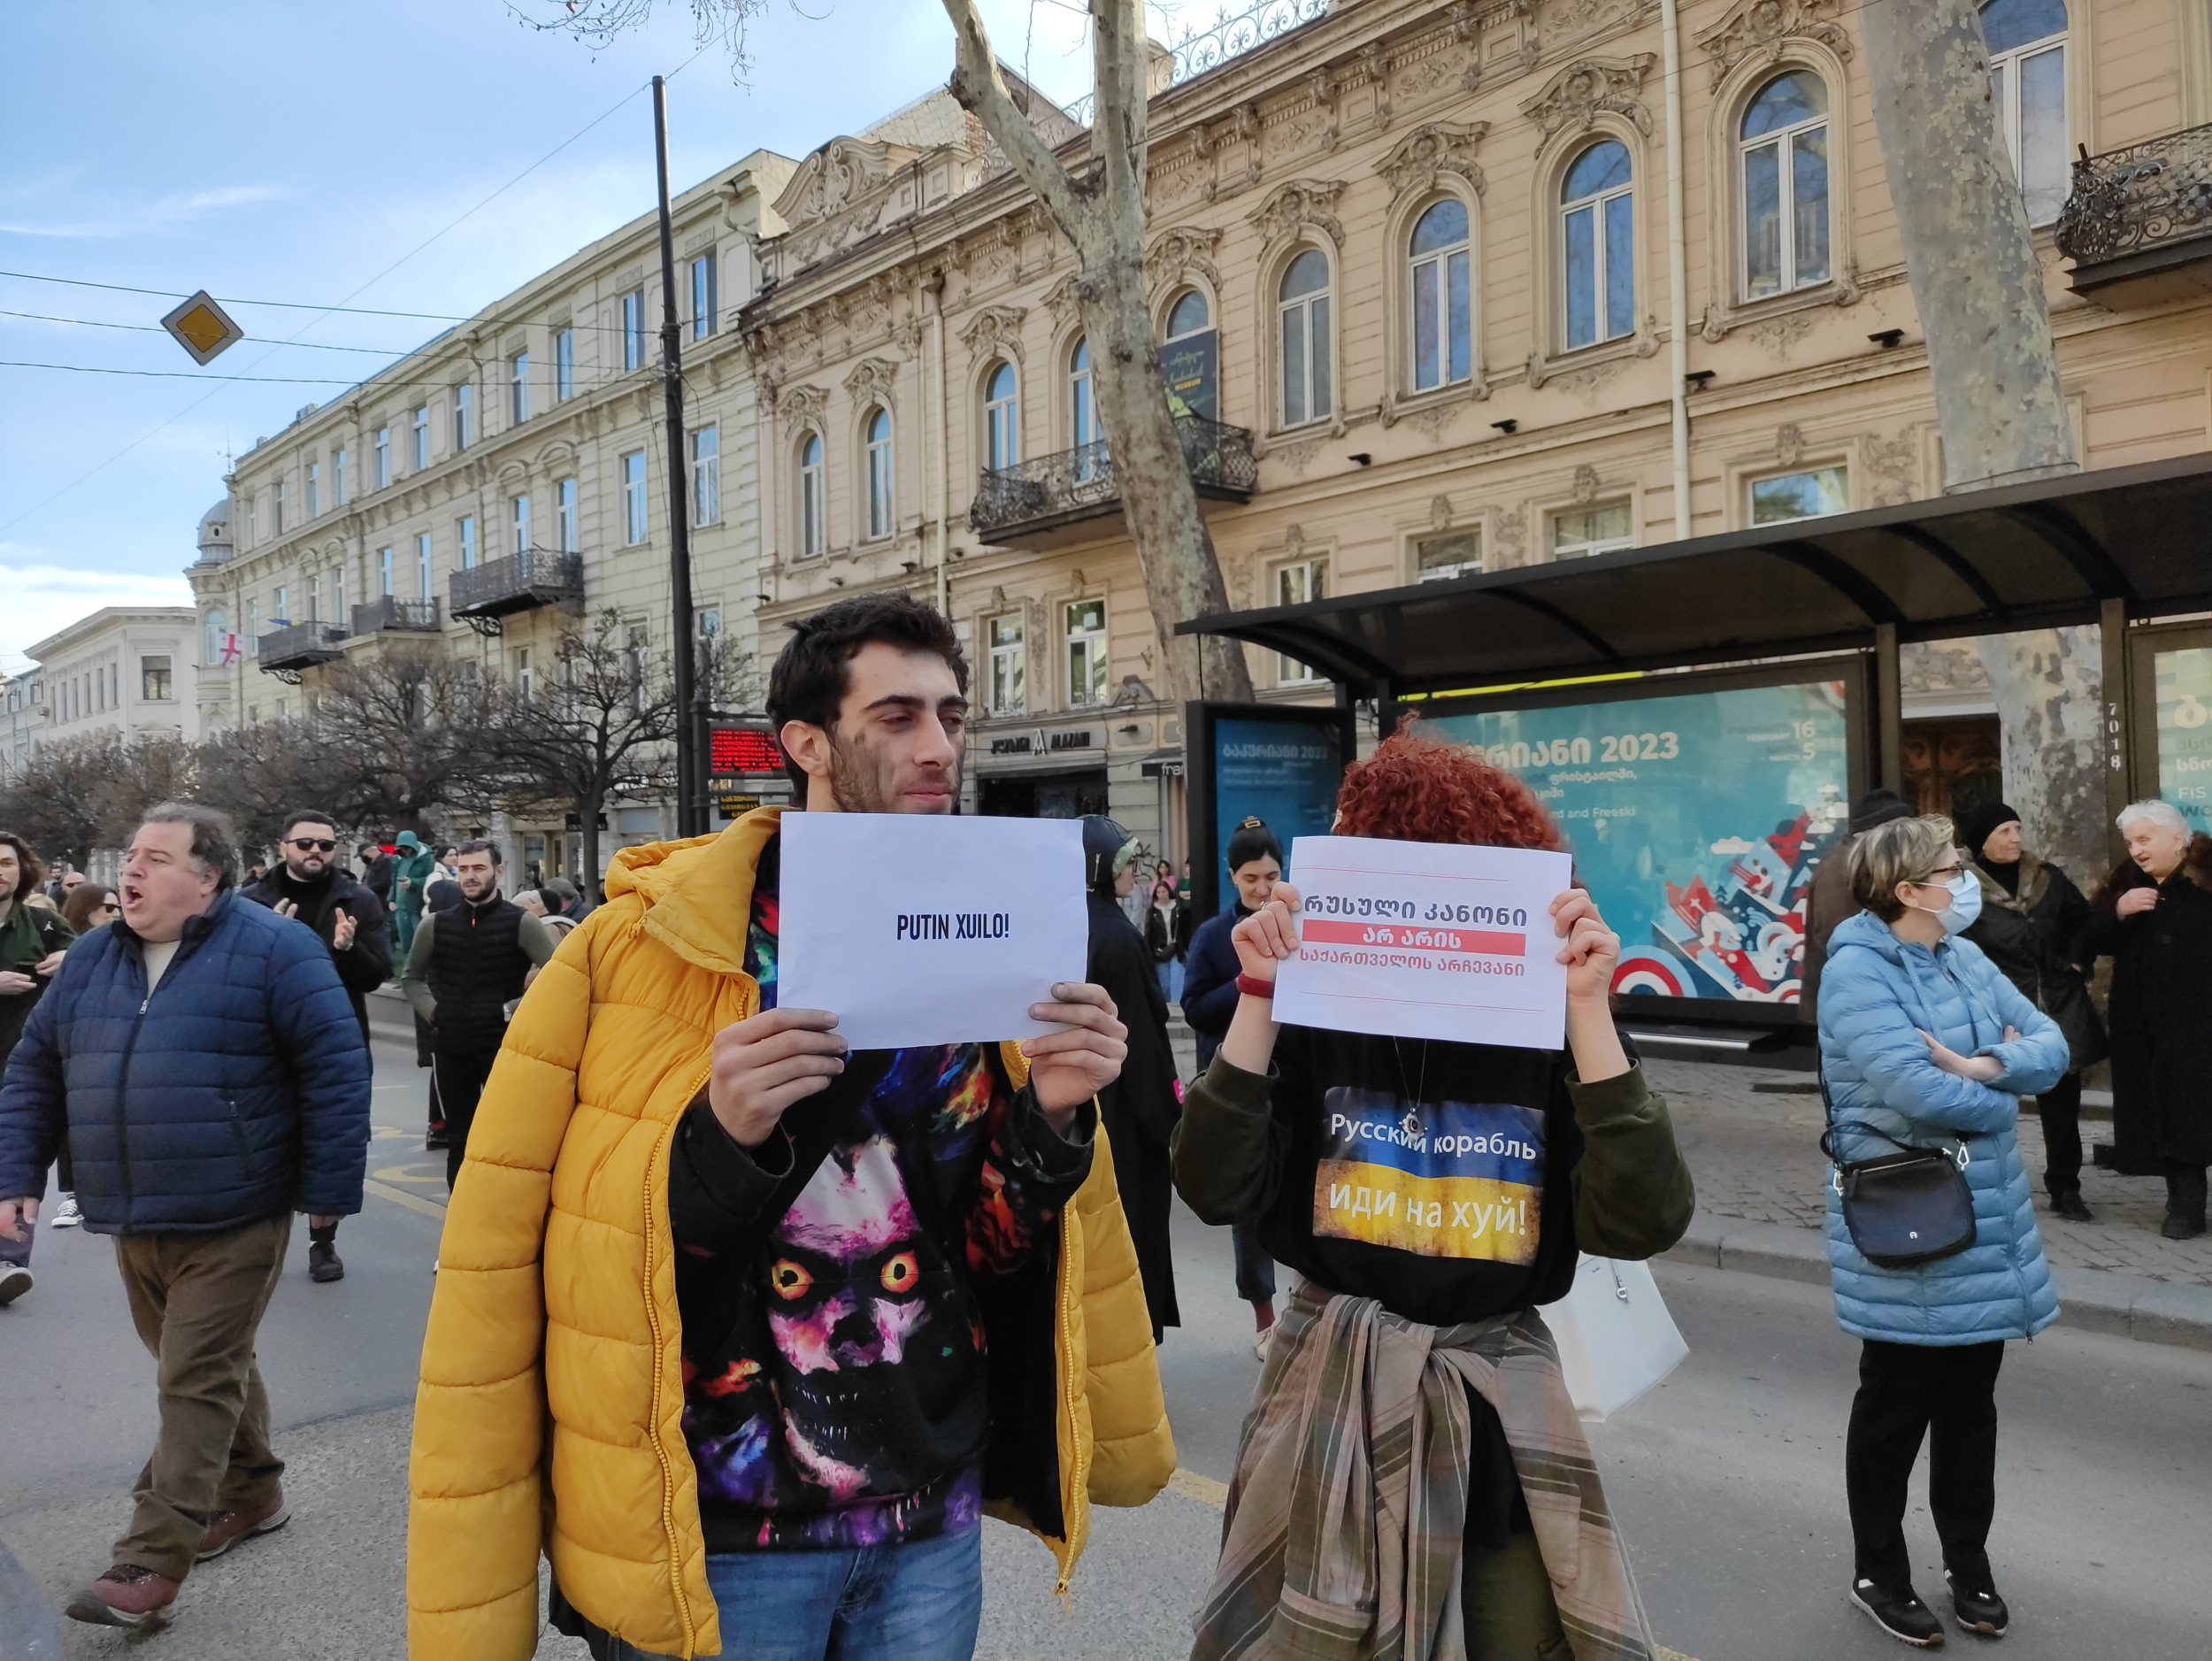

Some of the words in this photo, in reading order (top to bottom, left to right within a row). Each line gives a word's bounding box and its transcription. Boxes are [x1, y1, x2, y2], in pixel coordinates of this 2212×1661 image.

[1793, 721, 1816, 739] 16
[1599, 731, 1679, 763] 2023
[1802, 742, 1816, 760] 5
[2178, 786, 2208, 800] FIS
[1567, 807, 1589, 819] and
[1593, 805, 1636, 819] Freeski
[1304, 896, 1416, 919] რუსული
[1424, 903, 1527, 927] კანონი
[896, 914, 949, 941] PUTIN
[955, 913, 1009, 940] XUILO!
[1363, 927, 1394, 945] არ
[1401, 929, 1462, 950] არის
[1300, 948, 1432, 970] საქართველოს
[1437, 957, 1525, 977] არჩევანი
[1433, 1132, 1537, 1160] корабль
[1329, 1183, 1396, 1221] иди
[1406, 1196, 1442, 1227] на
[1451, 1195, 1526, 1240] хуй!
